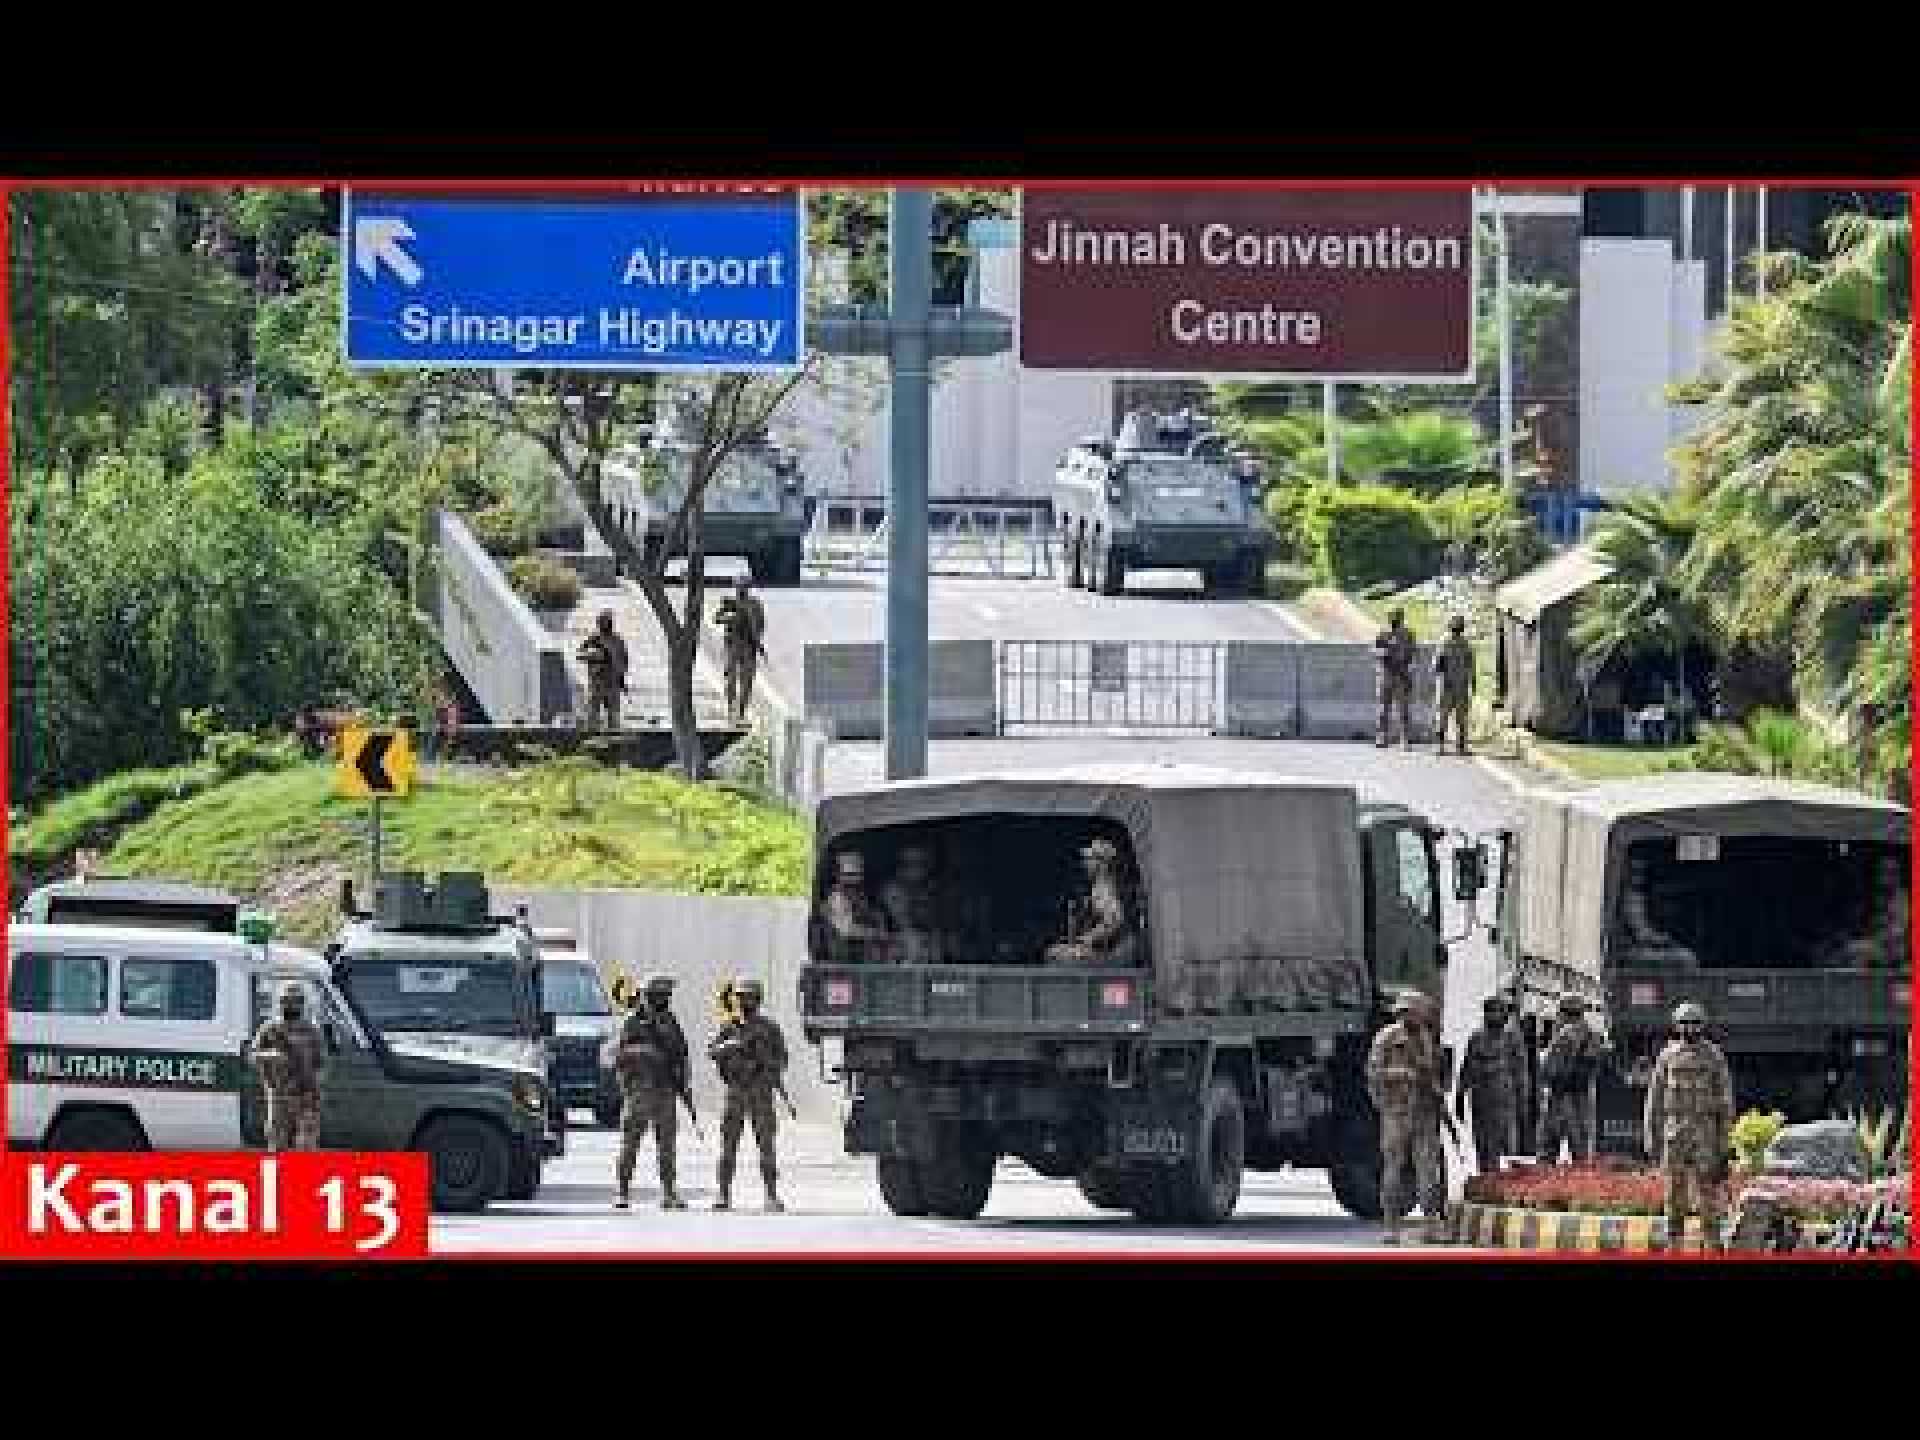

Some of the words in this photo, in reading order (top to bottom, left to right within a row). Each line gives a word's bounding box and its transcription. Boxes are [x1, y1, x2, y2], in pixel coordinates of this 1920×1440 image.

[1032, 220, 1187, 265] Jinnah
[1201, 224, 1462, 269] Convention
[623, 248, 784, 293] Airport
[401, 304, 584, 353] Srinagar
[599, 307, 781, 353] Highway
[1172, 299, 1322, 344] Centre
[27, 1055, 129, 1080] MILITARY
[135, 1058, 216, 1084] POLICE
